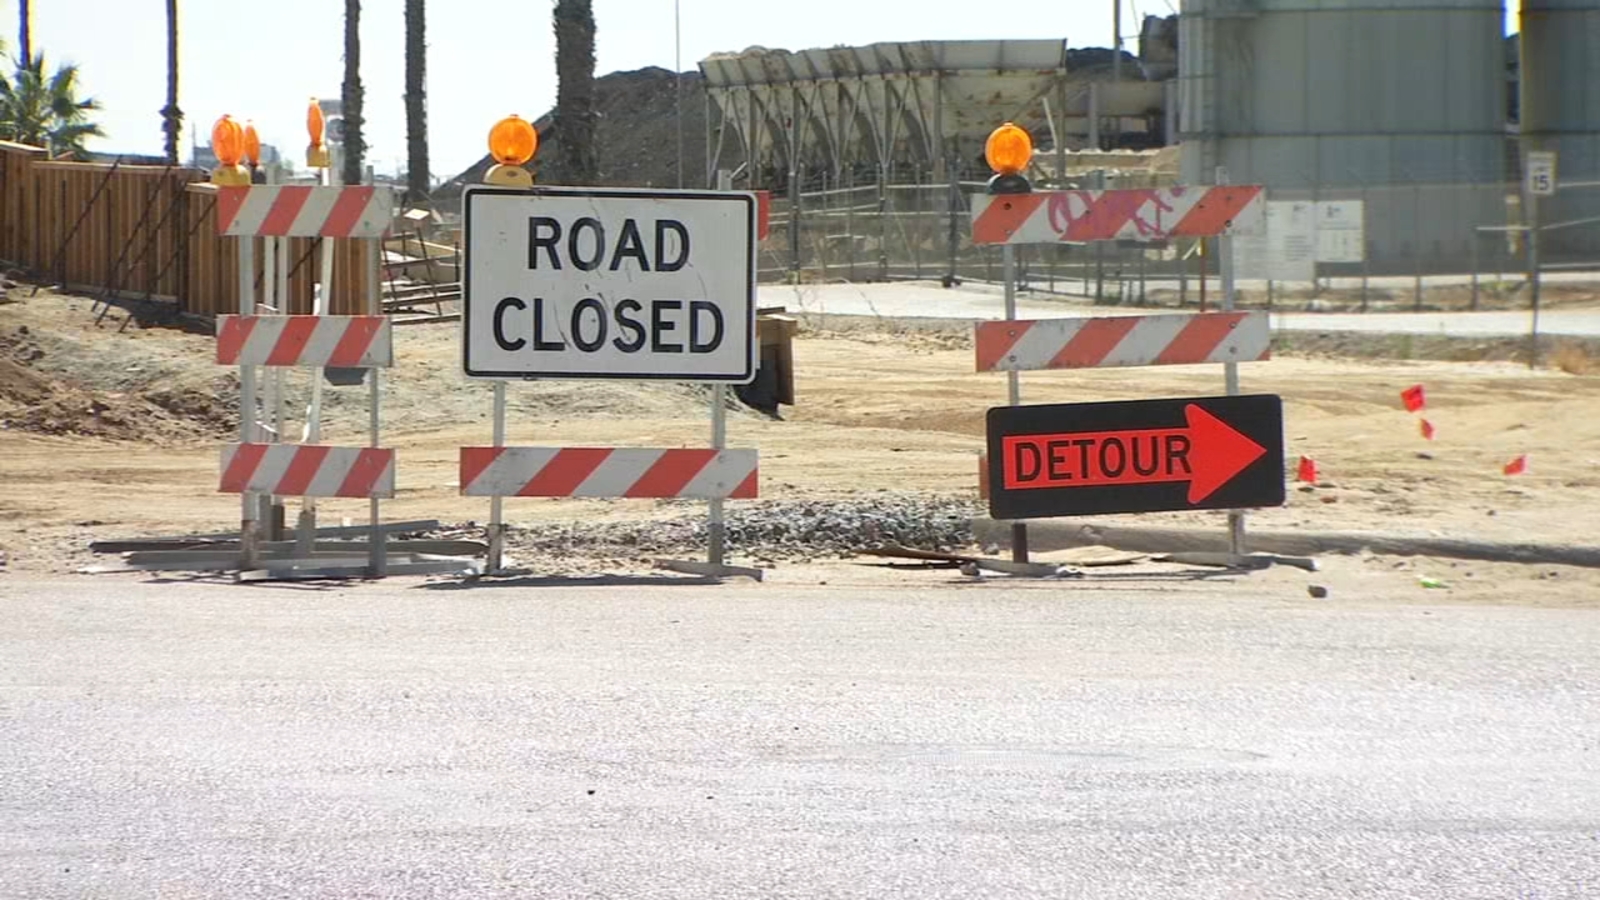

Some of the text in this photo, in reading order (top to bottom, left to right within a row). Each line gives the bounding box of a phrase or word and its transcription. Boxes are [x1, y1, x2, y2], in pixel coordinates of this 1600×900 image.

[1533, 174, 1550, 191] 15
[528, 216, 690, 272] ROAD
[492, 296, 725, 354] CLOSED
[1015, 434, 1192, 482] DETOUR
